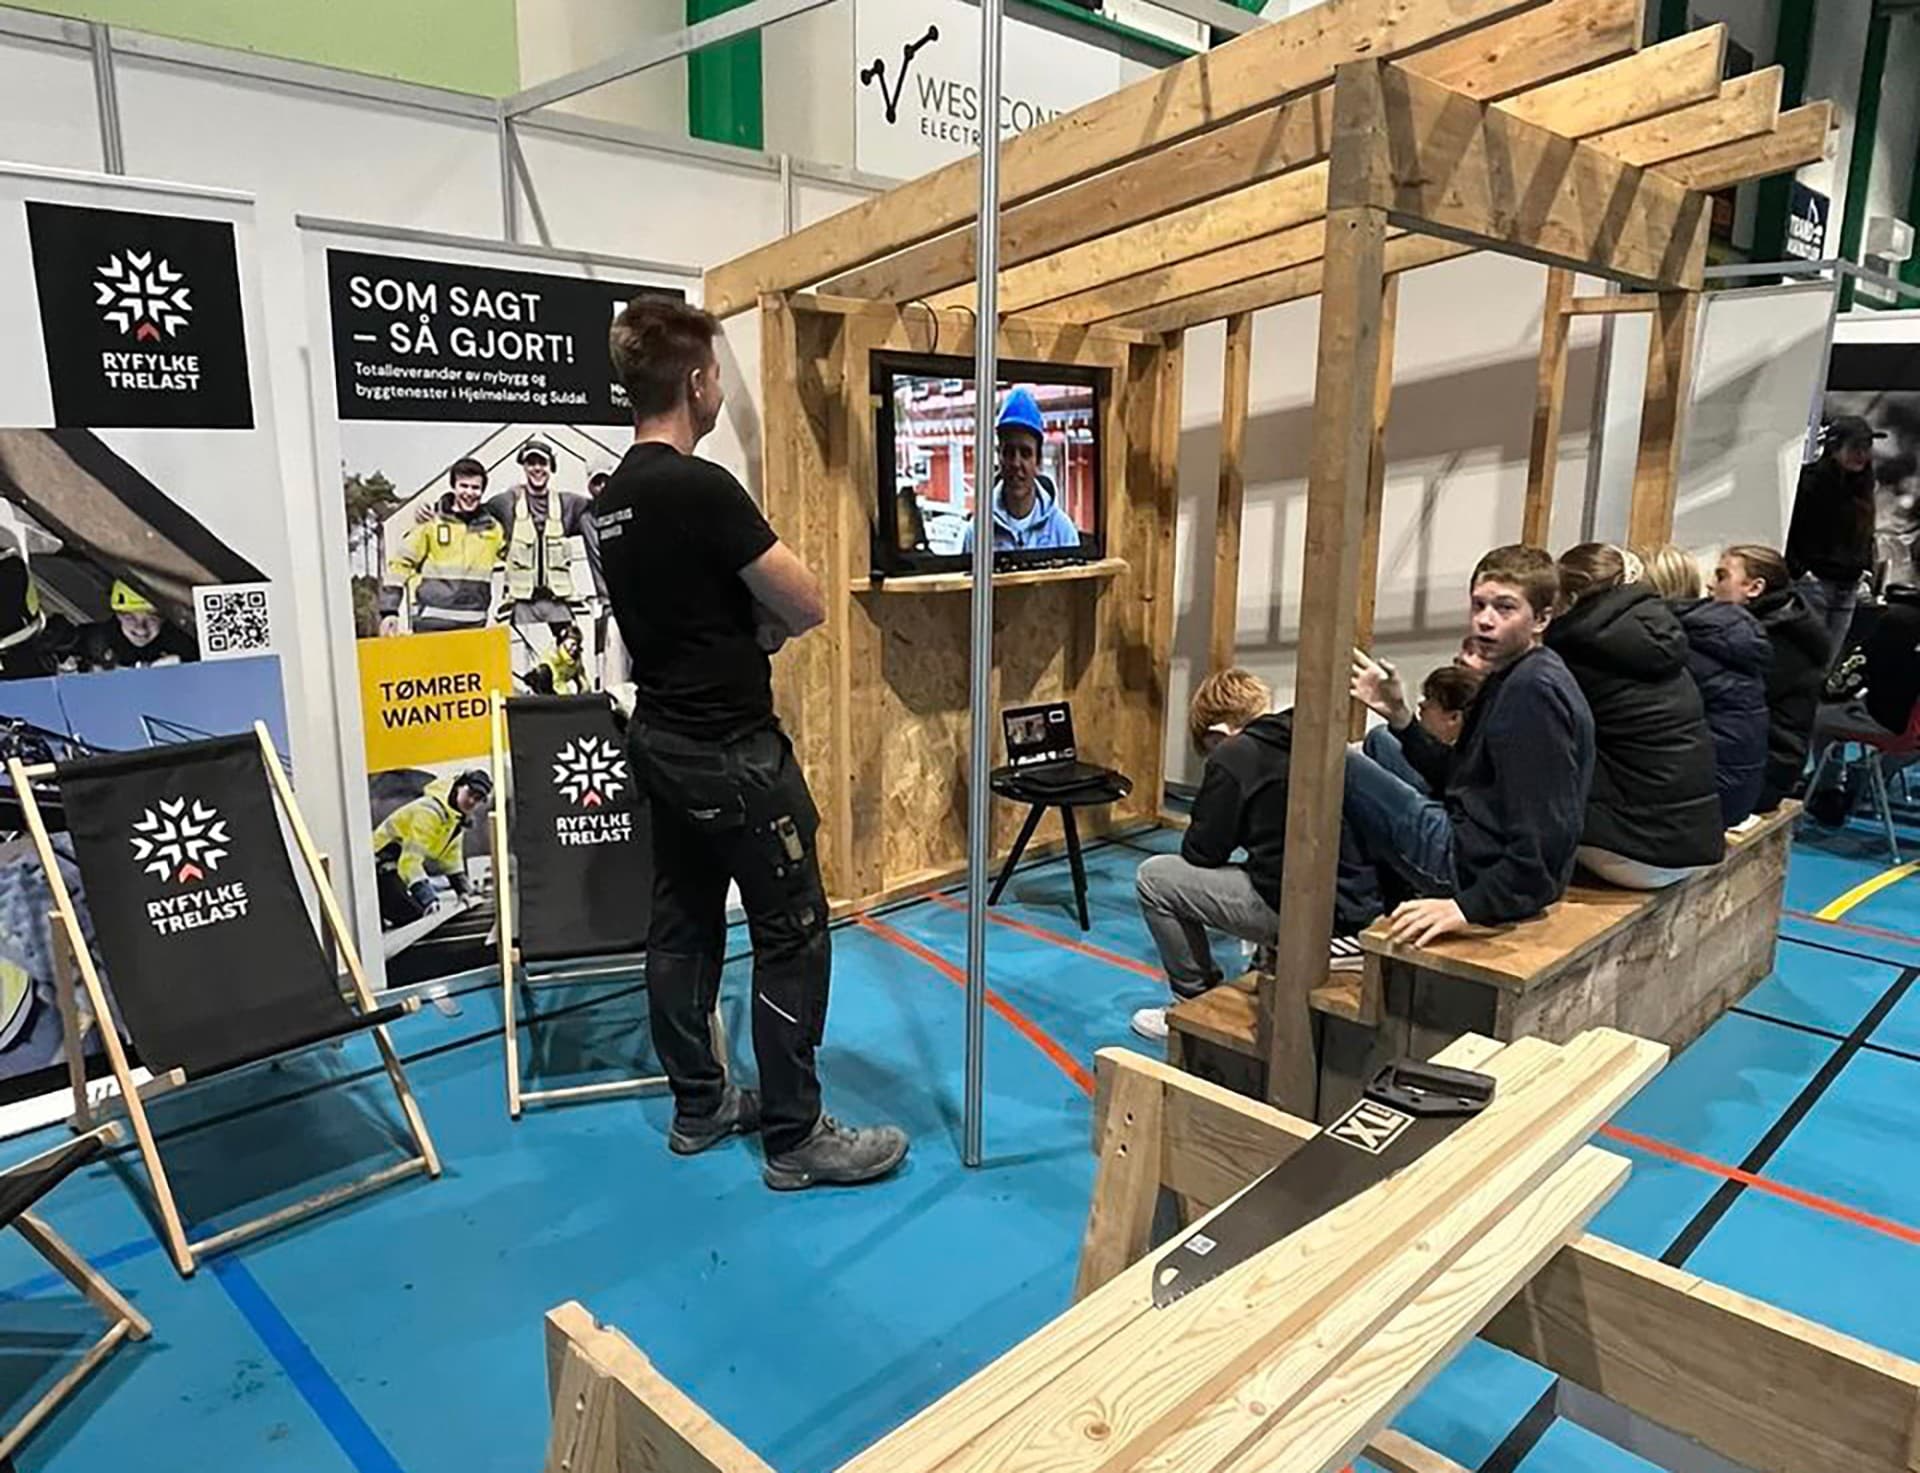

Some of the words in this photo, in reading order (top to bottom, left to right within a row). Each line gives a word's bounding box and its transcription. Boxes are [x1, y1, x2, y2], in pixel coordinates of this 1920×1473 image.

[921, 118, 982, 146] ELECTR
[350, 276, 437, 314] SOM
[450, 287, 541, 322] SAGT
[390, 314, 439, 355] SÅ
[450, 327, 574, 364] GJORT!
[102, 352, 200, 372] RYFYLKE
[354, 361, 462, 380] Totalleverandør
[465, 370, 481, 381] av
[483, 370, 529, 386] nybygg
[531, 374, 546, 388] og
[104, 372, 201, 391] TRELAST
[355, 382, 448, 400] byggtenester
[532, 392, 548, 406] og
[380, 673, 482, 702] TØMRER
[556, 812, 631, 831] RYFYLKE
[557, 827, 632, 845] TRELAST
[147, 882, 247, 918] RYFYLKE
[152, 899, 248, 935] TRELAST
